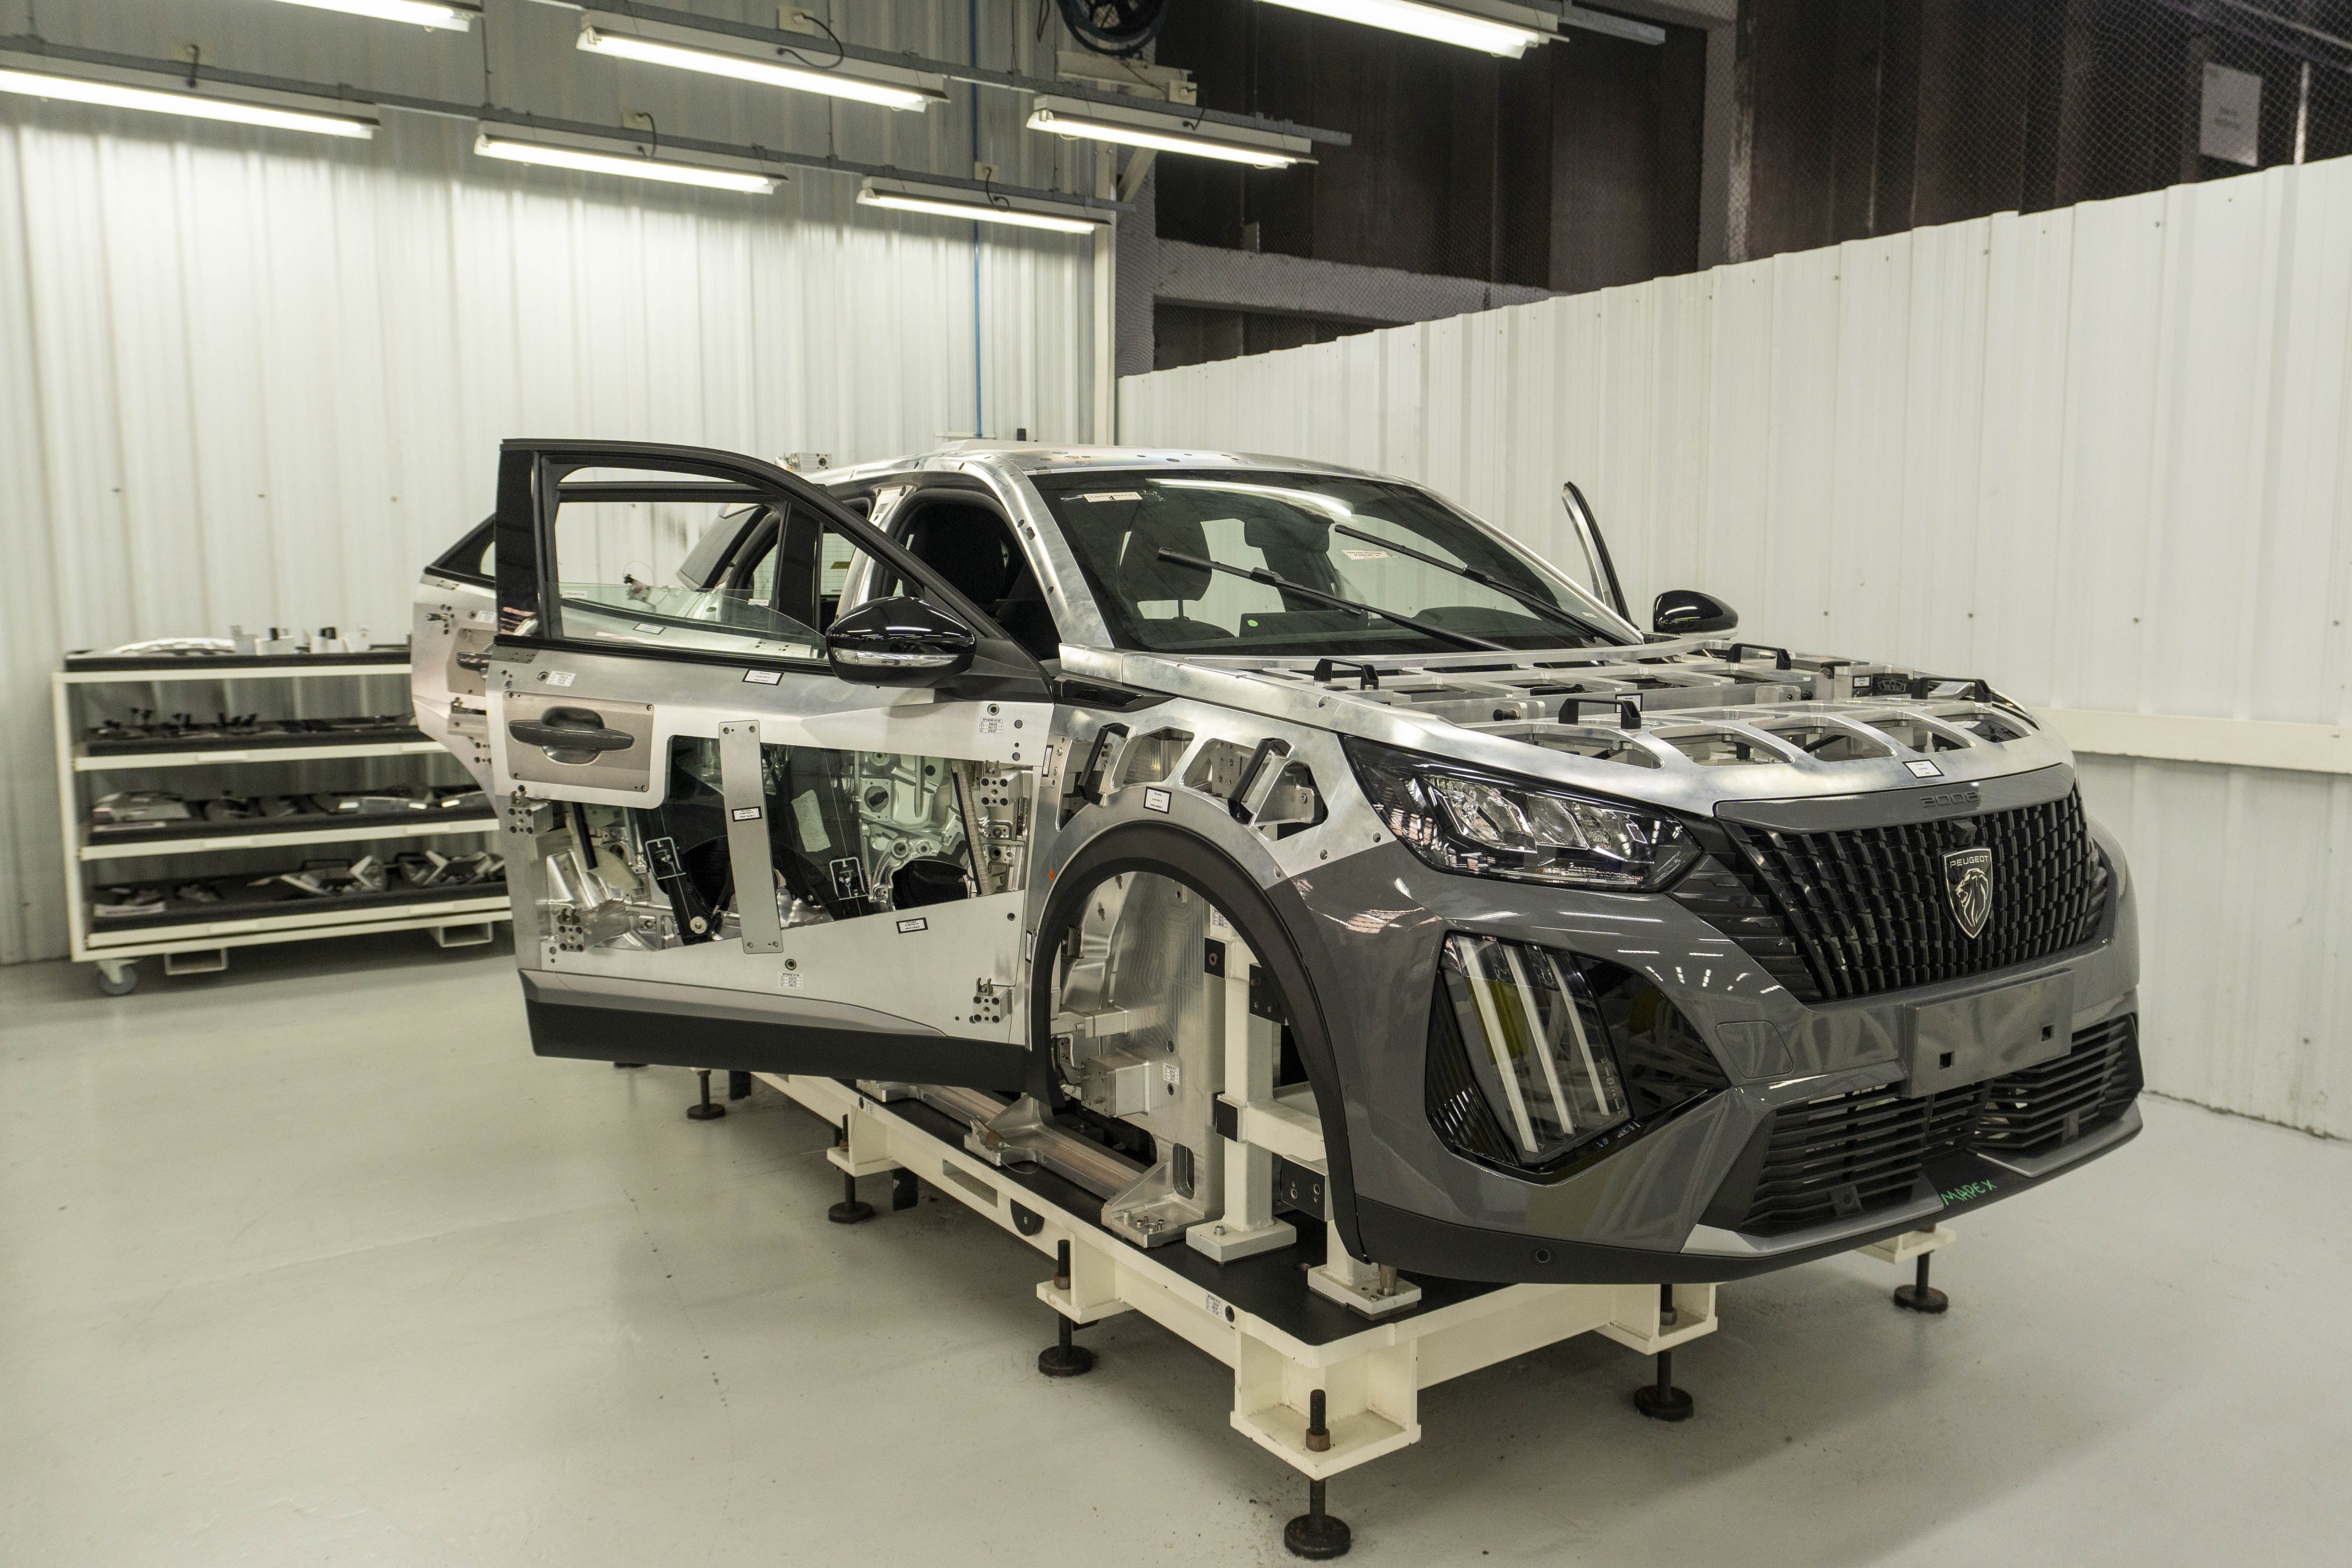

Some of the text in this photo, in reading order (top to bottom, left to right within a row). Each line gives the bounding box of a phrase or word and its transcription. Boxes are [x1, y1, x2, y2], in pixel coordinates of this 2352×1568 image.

[1920, 791, 1979, 808] 2008
[1950, 855, 1989, 868] PEUGEOT
[1940, 1179, 1997, 1205] MAPEX
